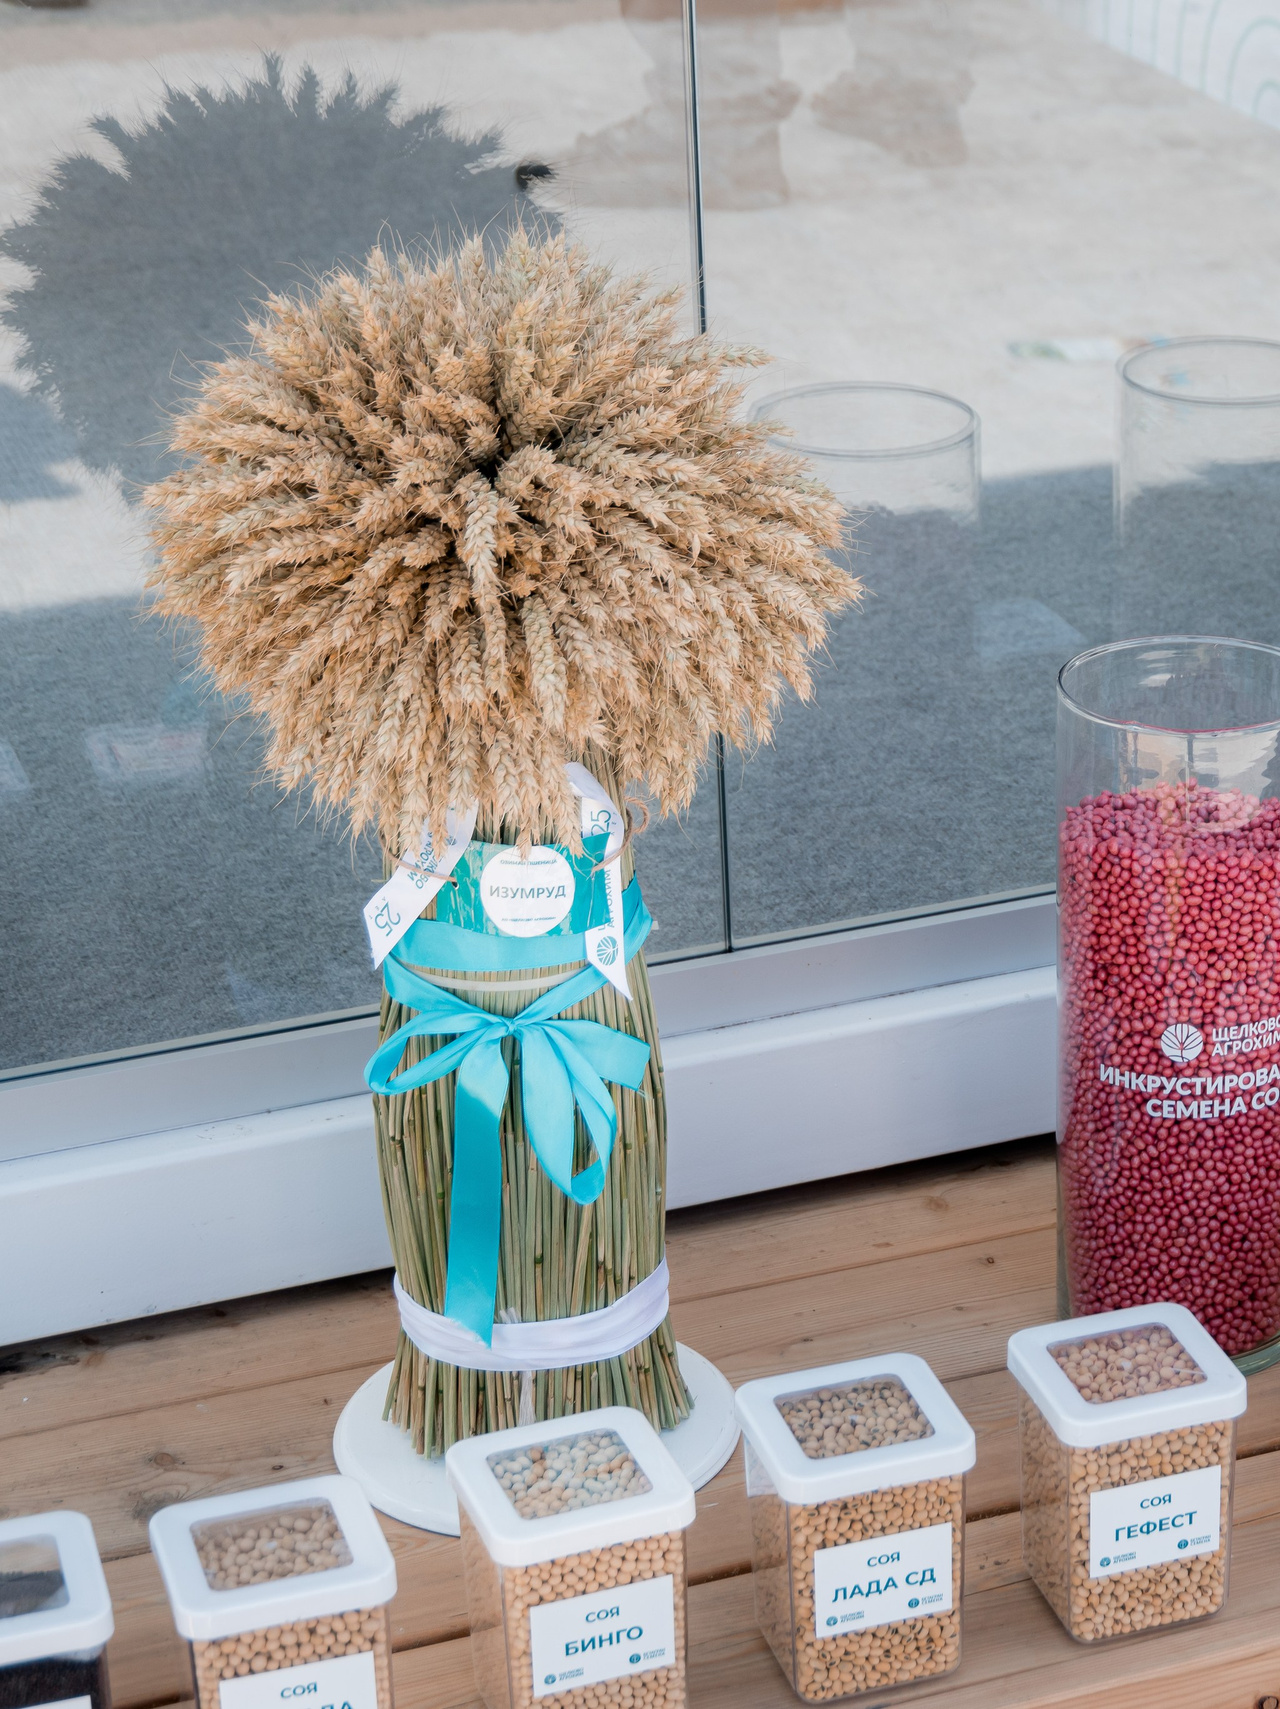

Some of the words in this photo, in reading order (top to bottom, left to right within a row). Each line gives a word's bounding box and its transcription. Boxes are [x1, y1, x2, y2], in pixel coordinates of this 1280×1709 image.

[489, 885, 566, 899] ИЗУМРУД
[374, 901, 401, 937] 25
[1146, 1096, 1247, 1119] СЕМЕНА
[1140, 1493, 1172, 1509] СОЯ
[1115, 1511, 1198, 1542] ГЕФЕСТ
[867, 1551, 900, 1567] СОЯ
[832, 1576, 899, 1603] ЛАДА
[905, 1567, 937, 1586] СД
[585, 1605, 620, 1623] СОЯ
[565, 1625, 644, 1657] БИНГО
[280, 1682, 318, 1699] СОЯ
